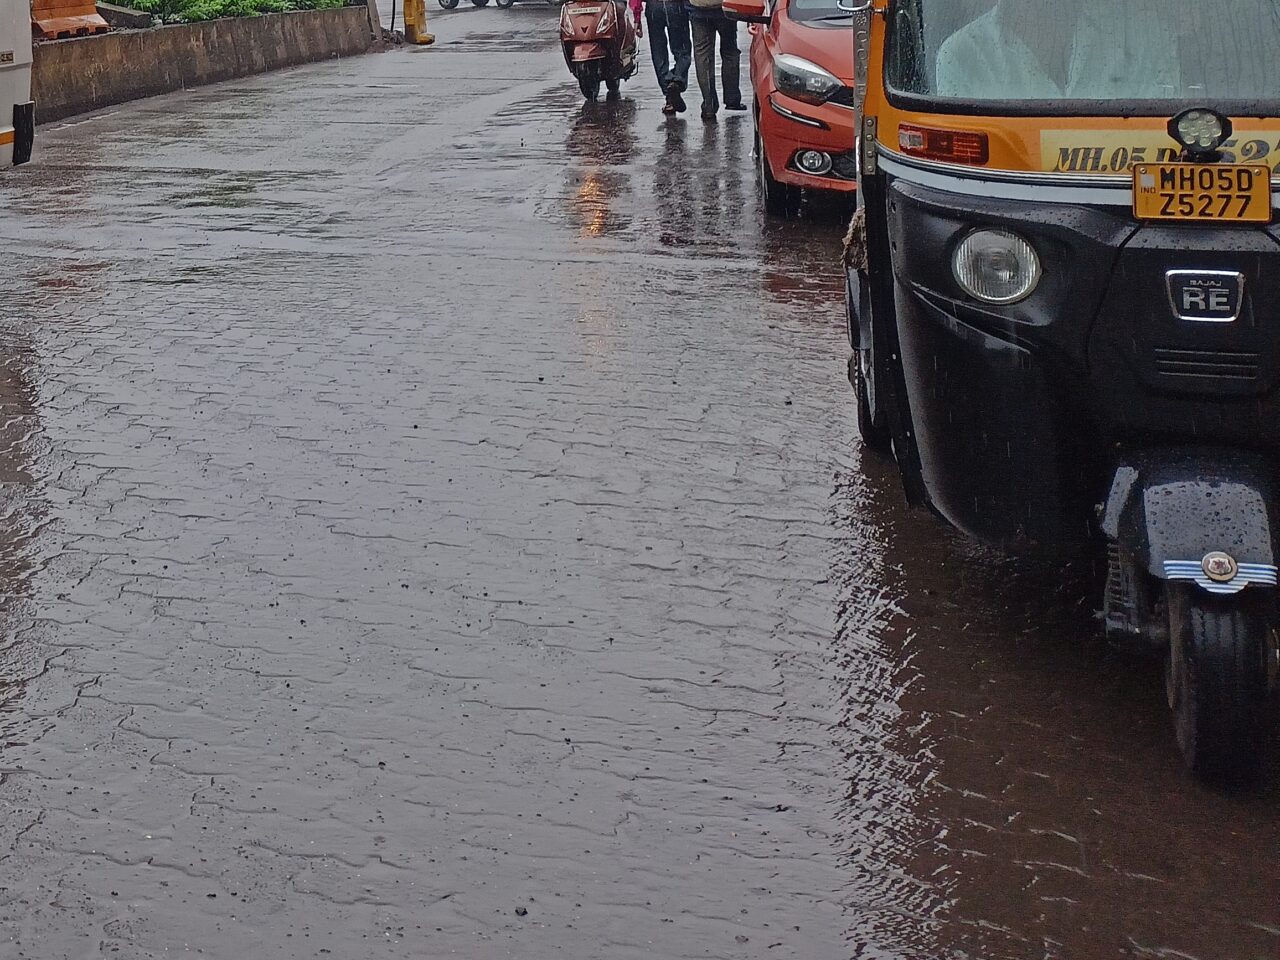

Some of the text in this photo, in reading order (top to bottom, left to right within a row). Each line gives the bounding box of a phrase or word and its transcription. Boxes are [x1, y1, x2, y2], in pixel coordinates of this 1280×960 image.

[1159, 166, 1254, 192] MH05D
[1159, 192, 1253, 218] Z5277
[1189, 279, 1222, 287] BAJAJ
[1182, 286, 1231, 311] RE
